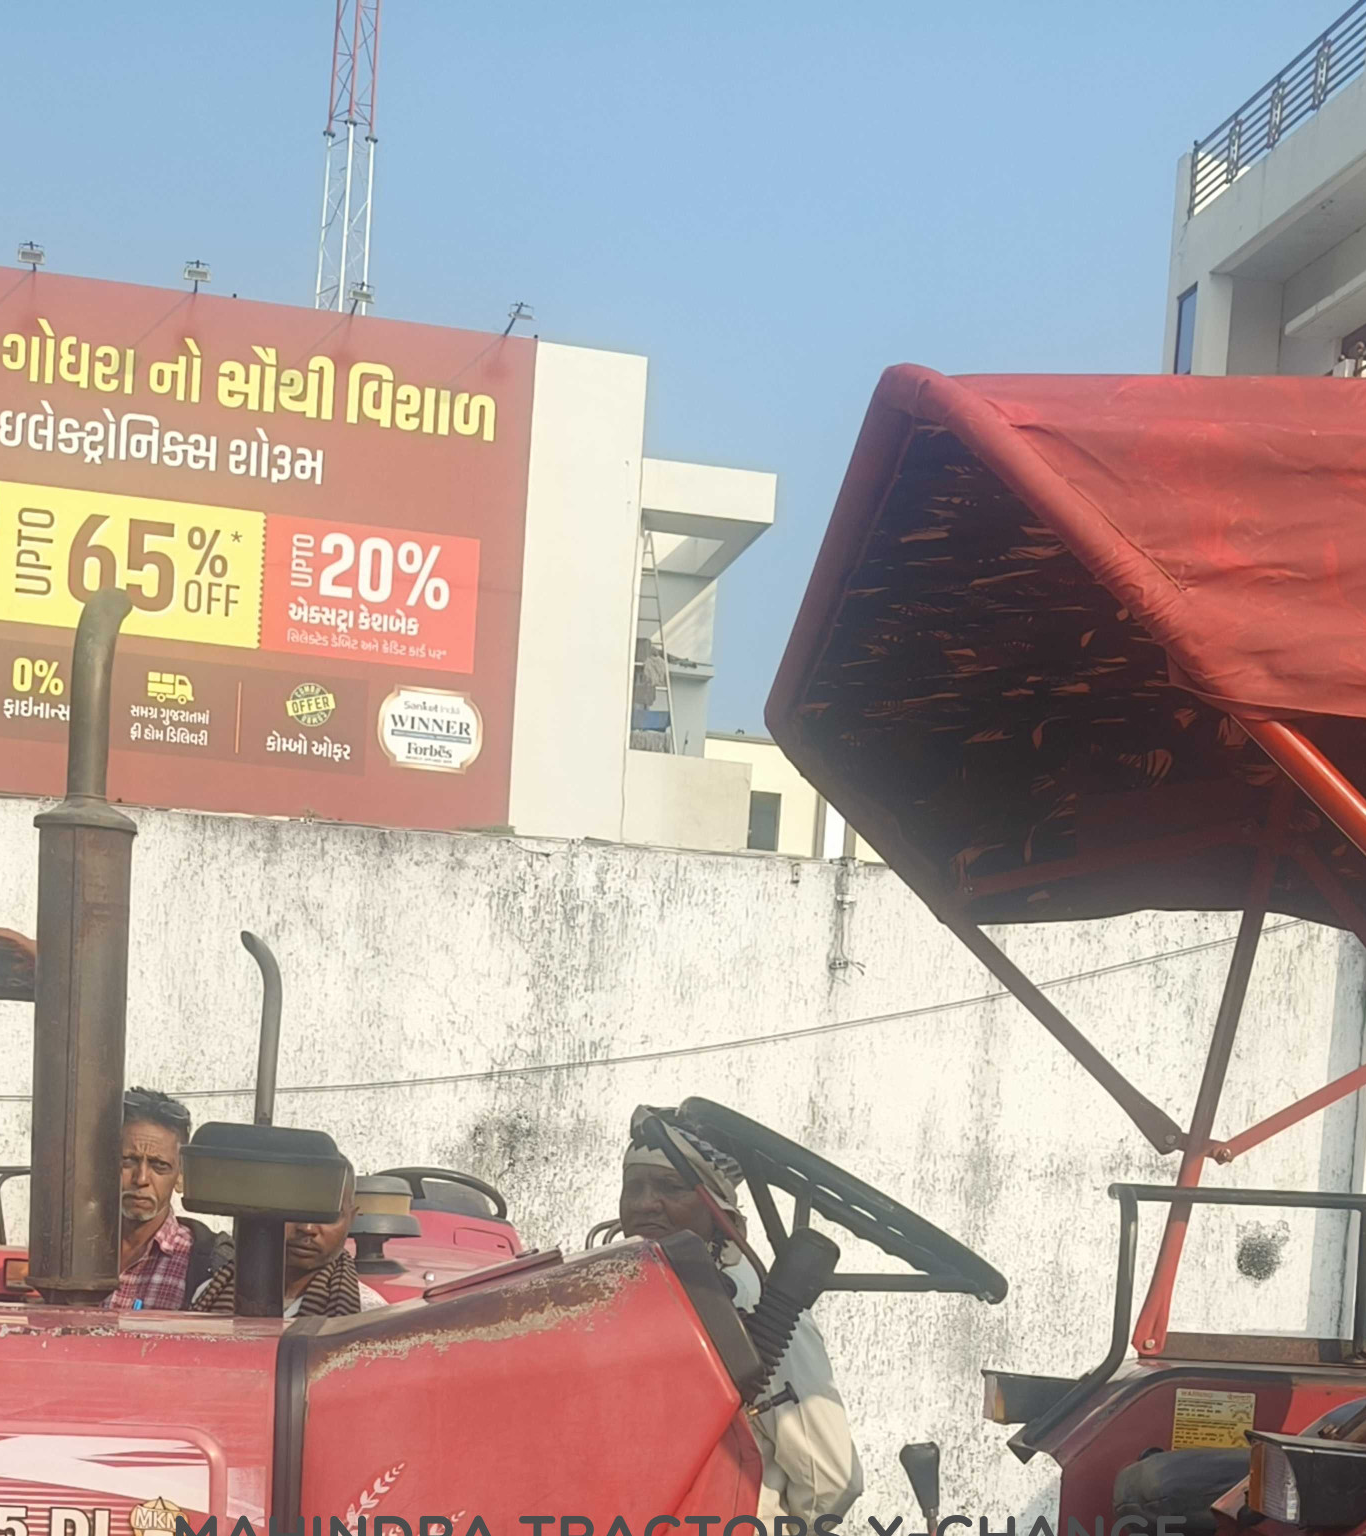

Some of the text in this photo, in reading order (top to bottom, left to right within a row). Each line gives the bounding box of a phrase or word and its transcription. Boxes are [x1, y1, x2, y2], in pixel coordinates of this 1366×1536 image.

[1, 317, 497, 443] ગોધરા નો સૌથી વિશાળ
[228, 427, 325, 486] શોરૂમ
[14, 506, 56, 596] UPTO
[290, 532, 451, 611] UPTO 20%
[184, 579, 241, 618] OFF
[357, 603, 420, 637] કેશબેક
[11, 656, 65, 696] 0%
[291, 695, 330, 714] OFFER
[390, 713, 472, 737] WINNER
[407, 741, 453, 759] Forbes
